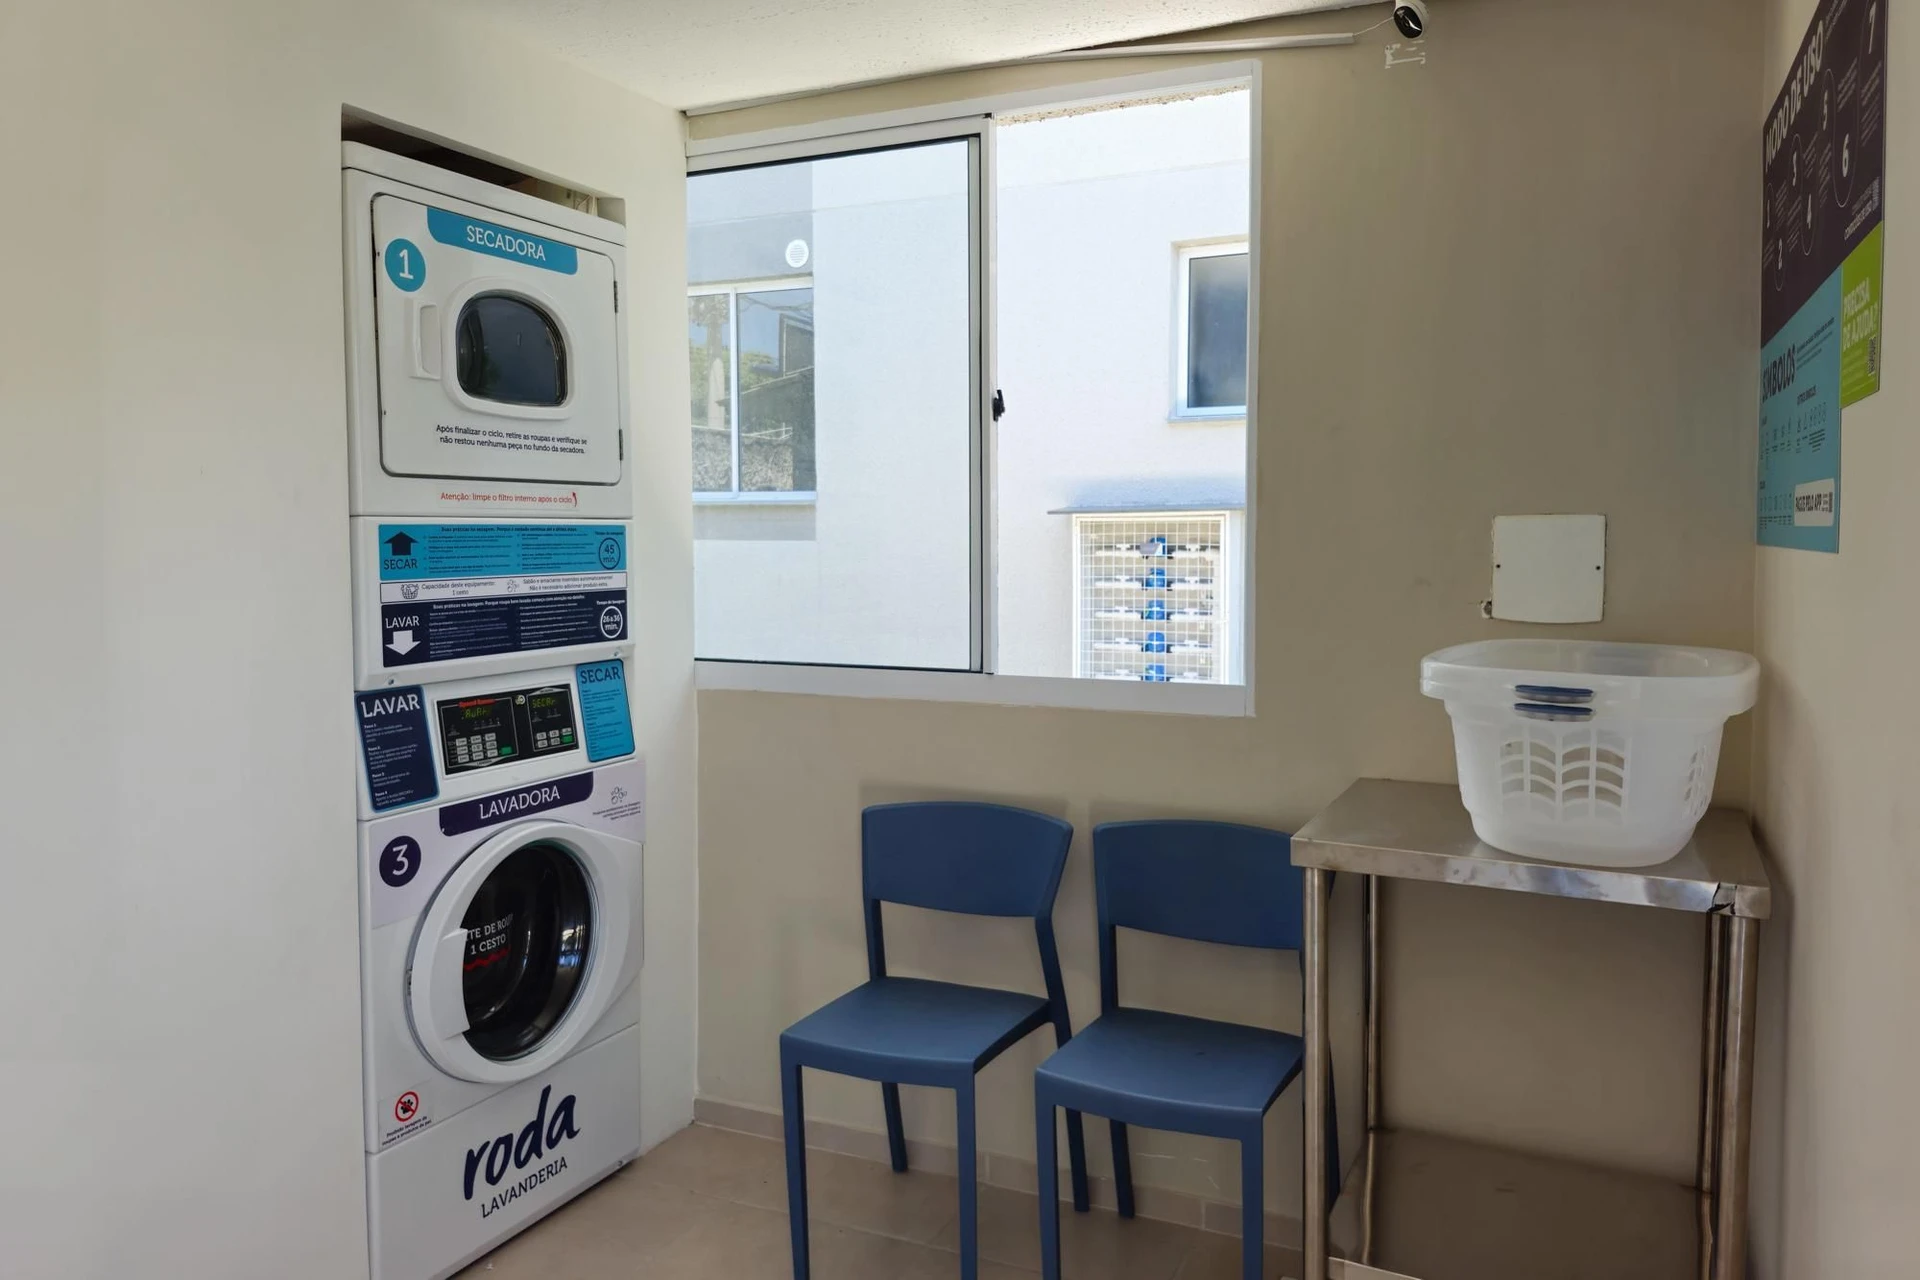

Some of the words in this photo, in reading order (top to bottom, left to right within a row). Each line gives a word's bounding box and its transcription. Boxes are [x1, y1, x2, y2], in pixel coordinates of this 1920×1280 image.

[1868, 0, 1876, 54] 7
[1766, 95, 1788, 173] MODO
[1790, 64, 1802, 125] DE
[1803, 20, 1823, 97] USO
[1842, 133, 1849, 178] 6
[466, 224, 546, 262] SECADORA
[399, 248, 414, 280] 1
[436, 424, 454, 434] Após
[454, 426, 480, 436] finalizar
[531, 435, 550, 443] roupas
[440, 435, 453, 444] não
[476, 439, 507, 448] nenhuma
[508, 442, 523, 451] peça
[533, 444, 551, 452] fundo
[472, 492, 491, 502] limpe
[498, 494, 514, 502] filtro
[605, 544, 615, 554] 45
[384, 558, 418, 570] SECAR
[421, 582, 450, 590] Capacidade
[385, 616, 420, 628] LAVAR
[580, 666, 621, 684] SECAR
[360, 694, 420, 718] LAVAR
[480, 786, 560, 820] LAVADORA
[392, 844, 409, 876] 3
[484, 922, 497, 936] DE
[471, 944, 477, 955] 1
[479, 933, 506, 952] CESTO
[464, 1084, 581, 1201] roda
[481, 1156, 568, 1218] LAVANDERIA
